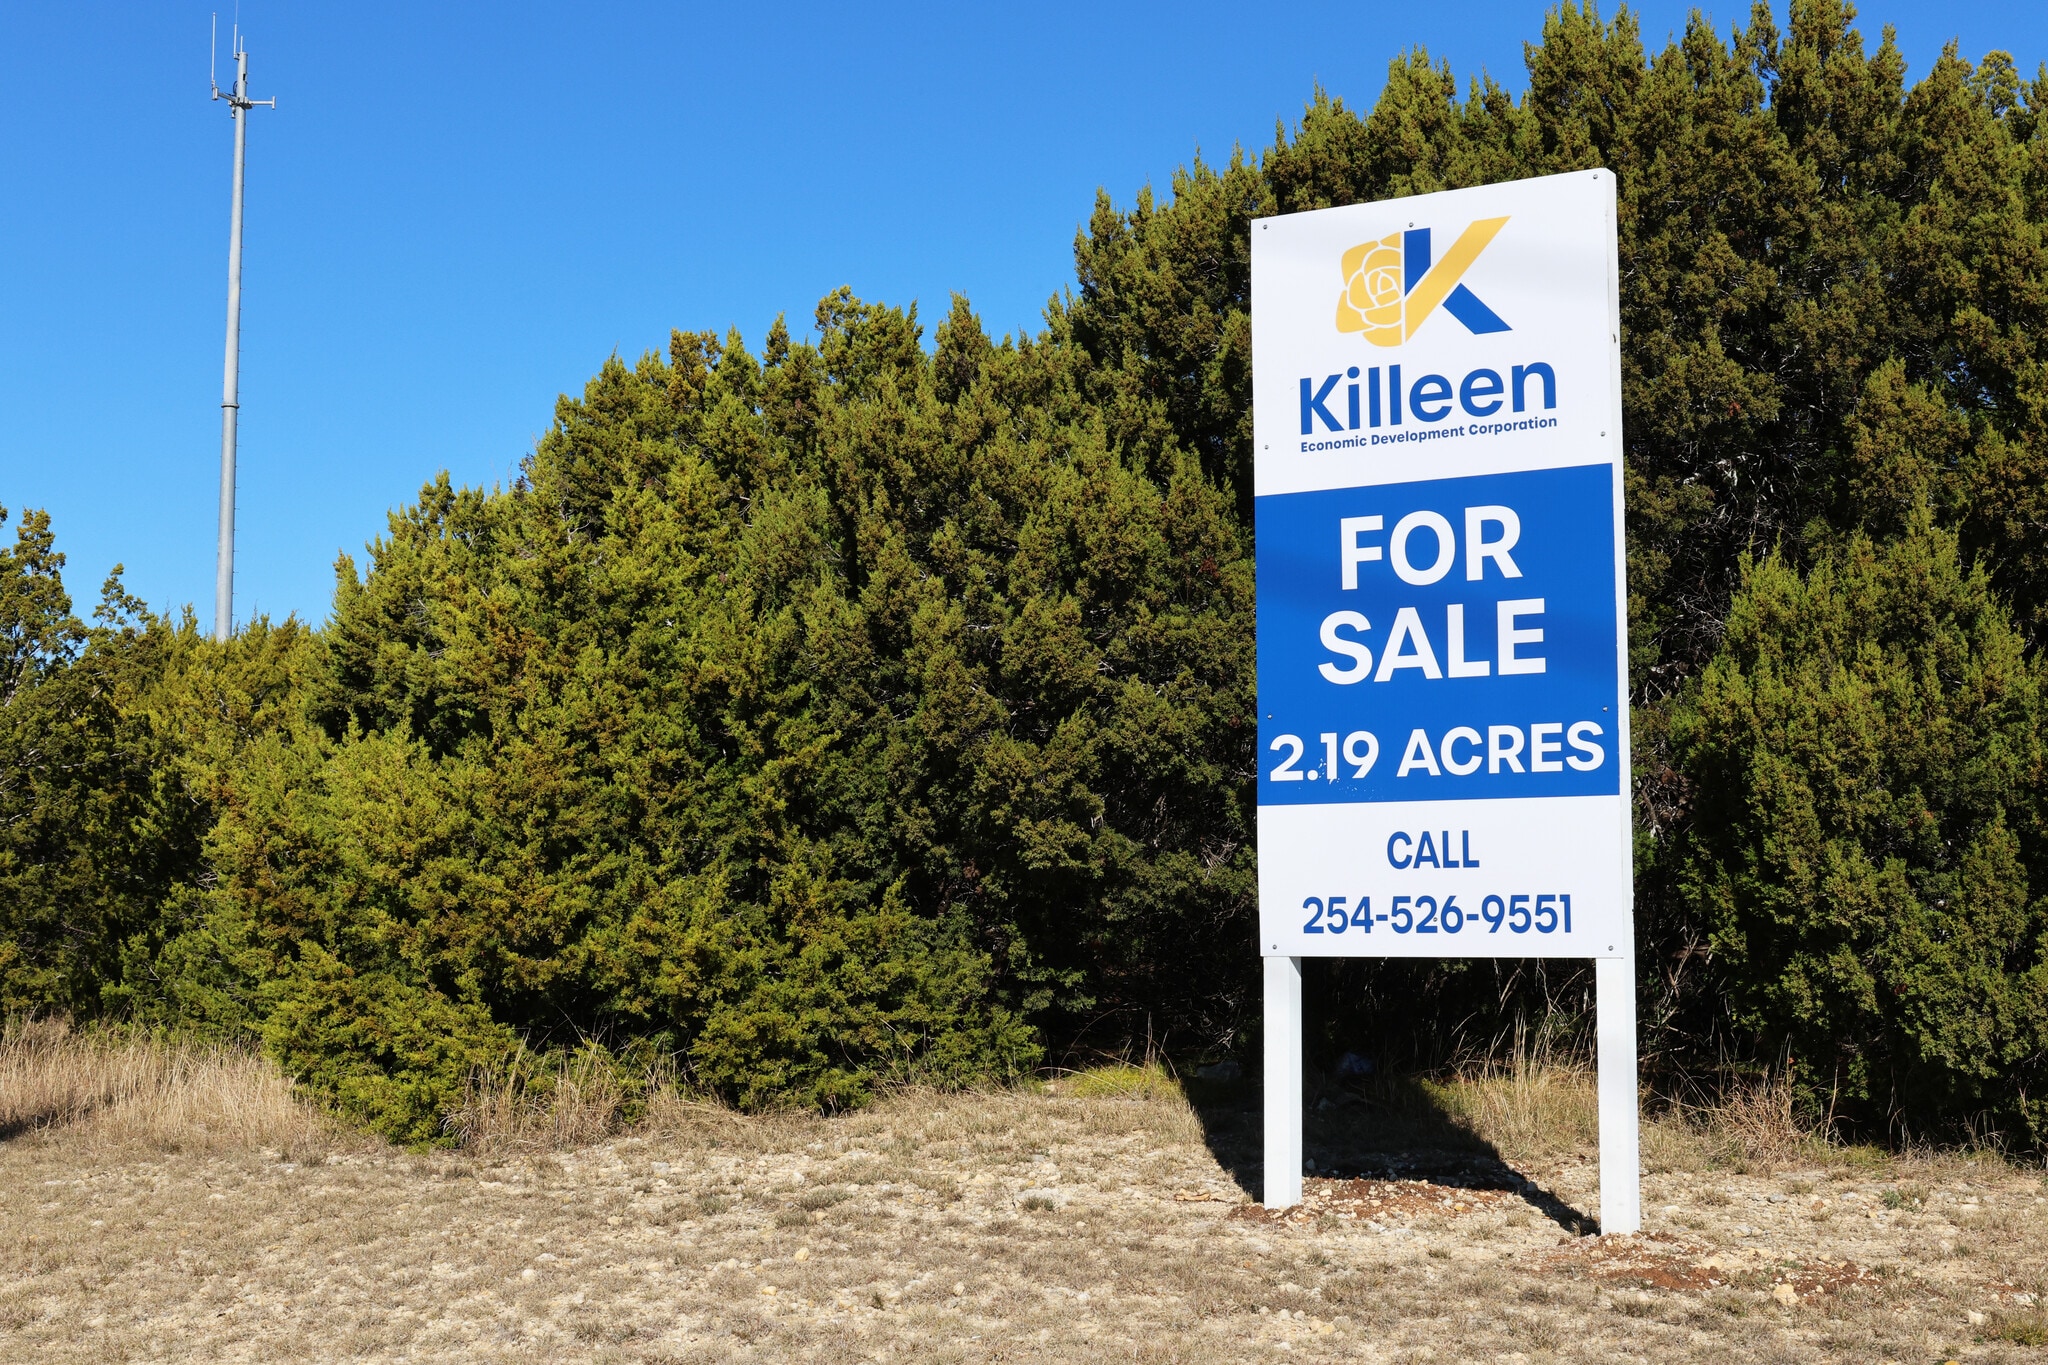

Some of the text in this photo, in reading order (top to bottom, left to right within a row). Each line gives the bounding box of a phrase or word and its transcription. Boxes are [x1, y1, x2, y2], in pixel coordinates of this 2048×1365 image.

[1299, 361, 1557, 435] Killeen
[1300, 416, 1558, 453] Economic Development Corporation
[1340, 505, 1524, 591] FOR
[1317, 598, 1547, 685] SALE
[1269, 720, 1605, 782] 2.19 ACRES
[1386, 830, 1480, 870] CALL
[1302, 894, 1572, 935] 254-526-9551
